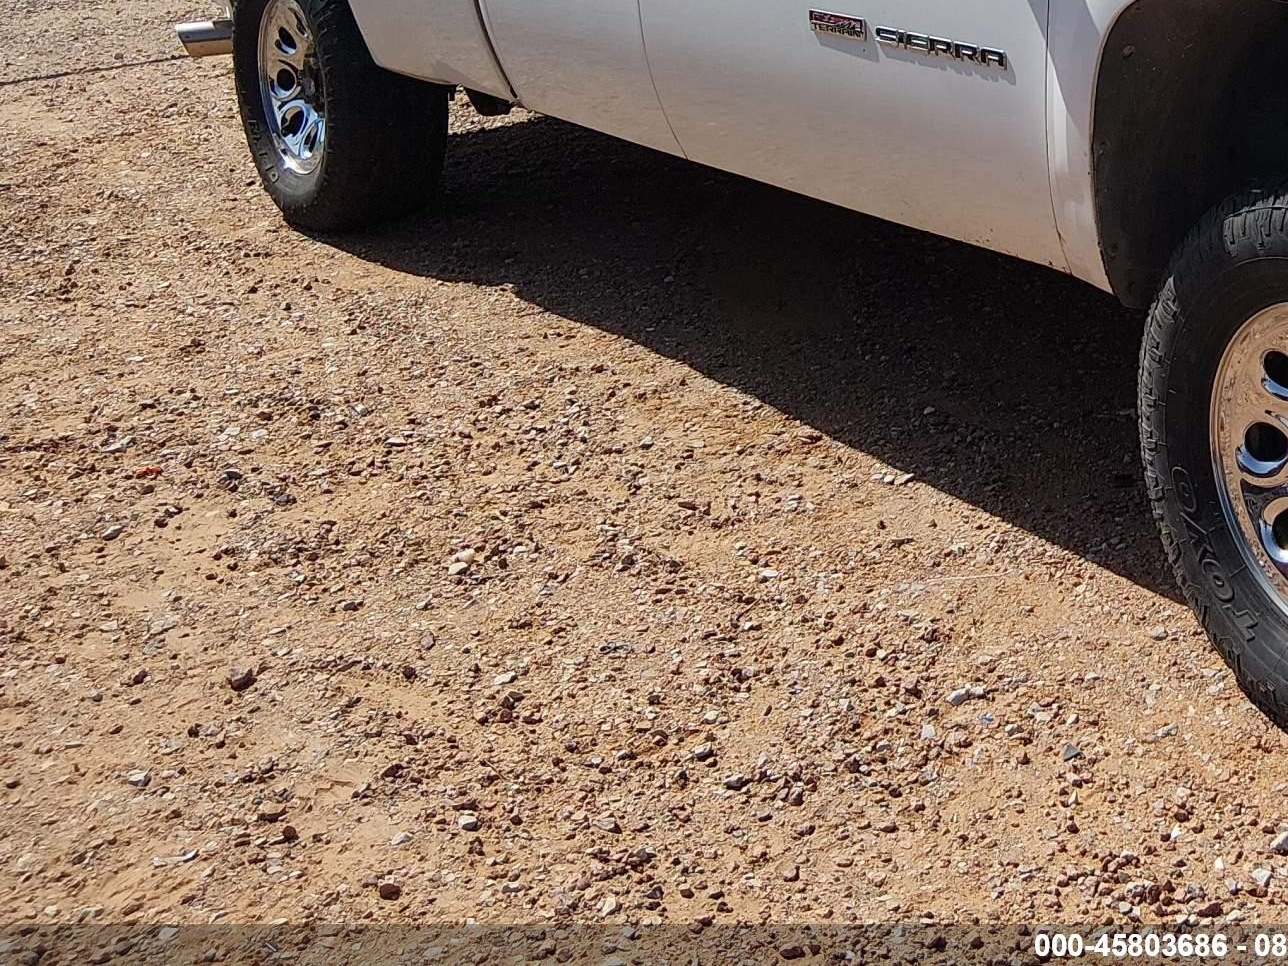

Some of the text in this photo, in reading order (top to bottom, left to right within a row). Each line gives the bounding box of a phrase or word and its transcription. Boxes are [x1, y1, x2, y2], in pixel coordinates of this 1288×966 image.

[811, 23, 865, 38] TERRAIN
[875, 25, 1008, 70] SIERRA
[1171, 465, 1258, 643] TOYO
